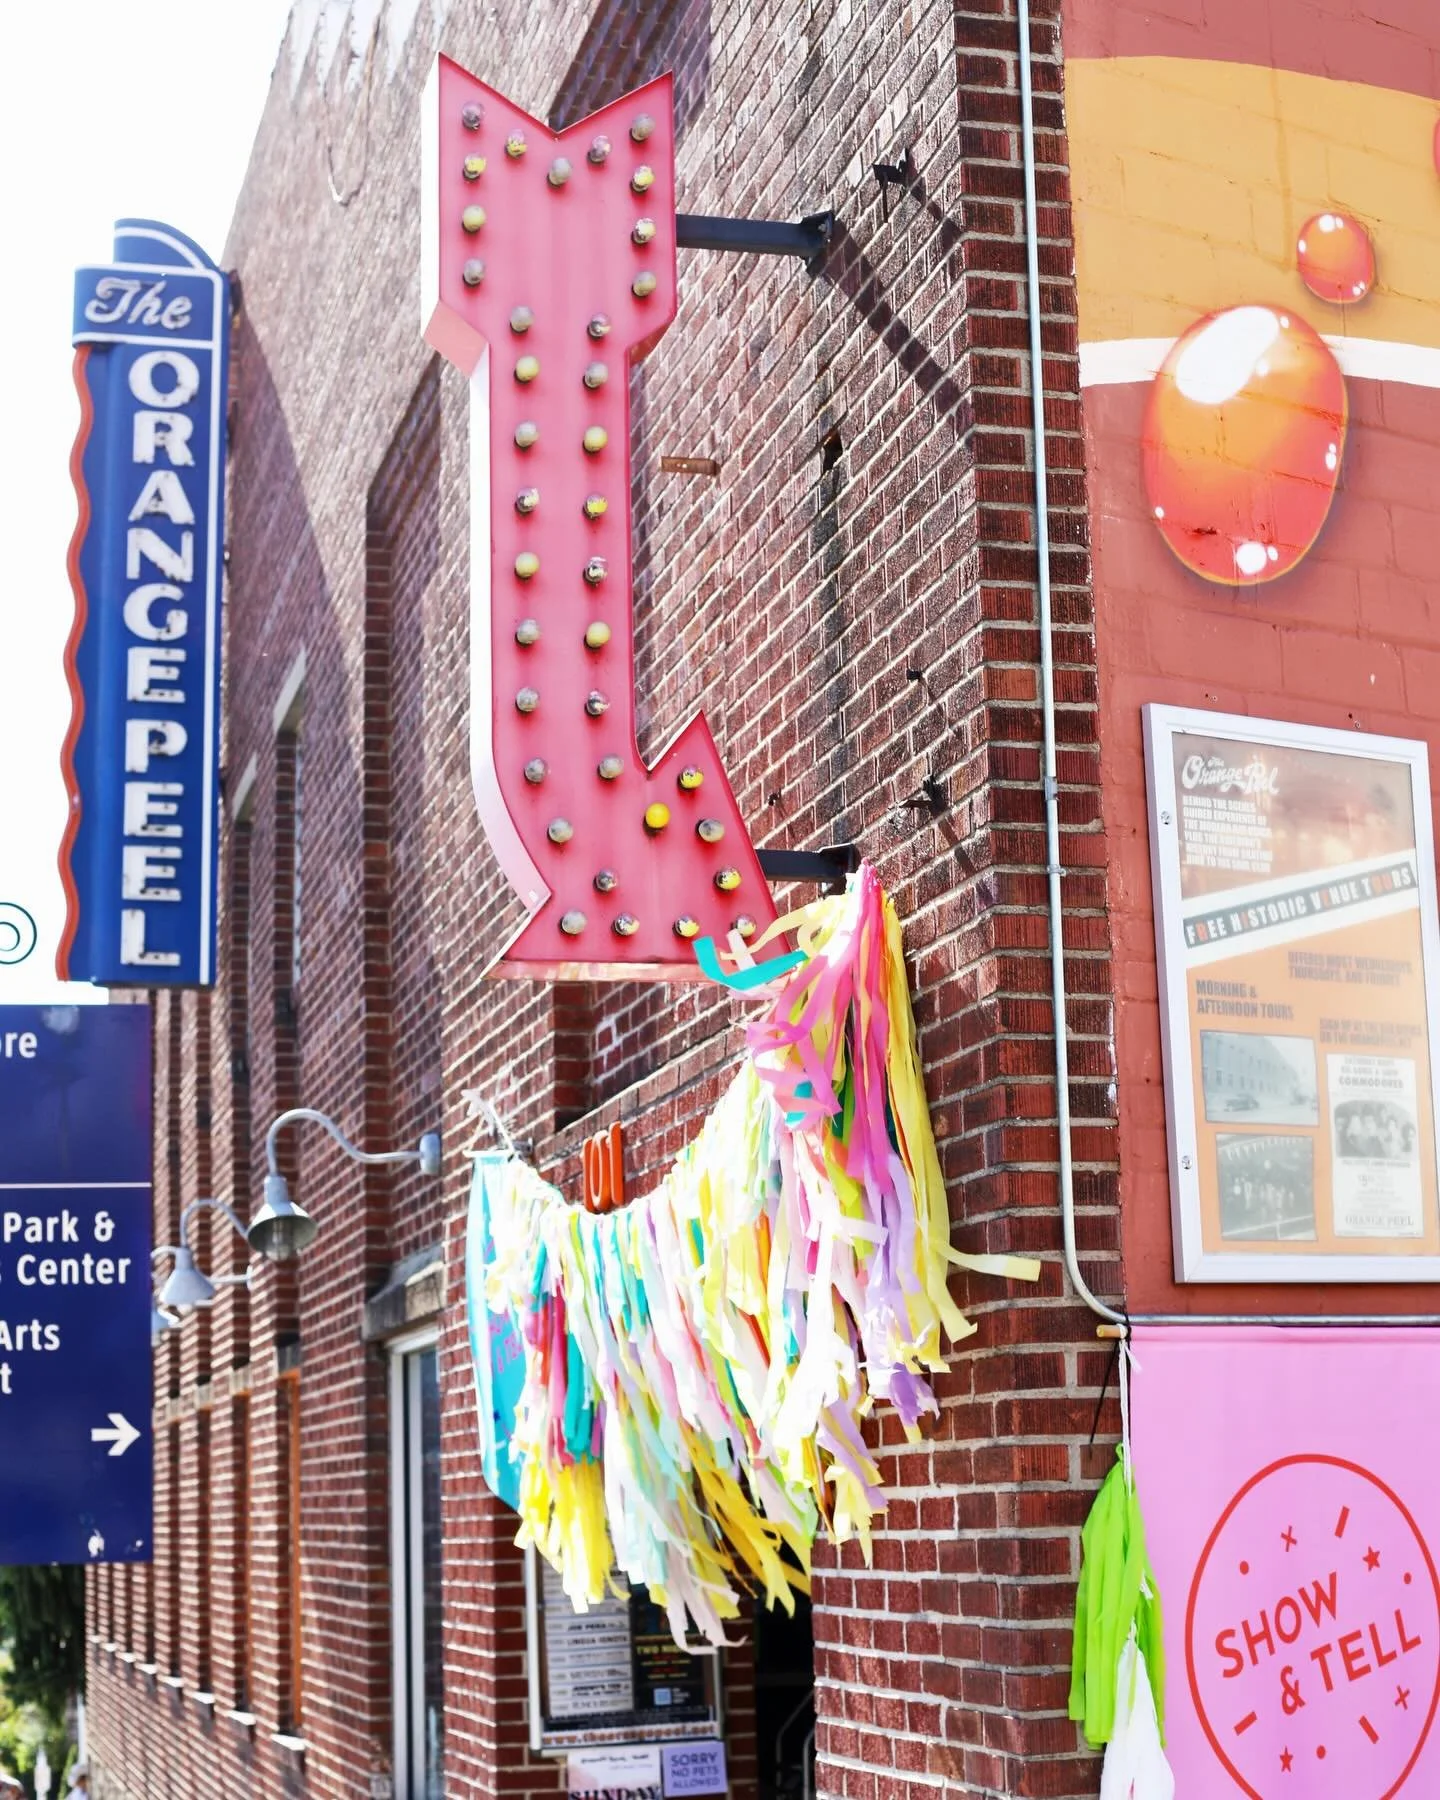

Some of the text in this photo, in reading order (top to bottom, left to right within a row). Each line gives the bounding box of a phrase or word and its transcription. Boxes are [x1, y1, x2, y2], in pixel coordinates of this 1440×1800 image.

[85, 276, 192, 330] The
[119, 350, 200, 968] ORANGE PEEL
[1182, 755, 1244, 793] Orange
[1186, 868, 1412, 946] FREE HISTORIC VENUE TOURS
[1196, 980, 1247, 998] MORNING
[1197, 999, 1294, 1020] AFTERNOON TOURS
[0, 1032, 38, 1058] re
[4, 1209, 115, 1243] Park &
[17, 1253, 131, 1286] Center
[1215, 1571, 1337, 1679] SHOW
[1280, 1608, 1421, 1715] & TELL
[671, 1752, 718, 1767] SORRY
[671, 1766, 719, 1779] NO PETS
[673, 1777, 720, 1790] ALLOWED
